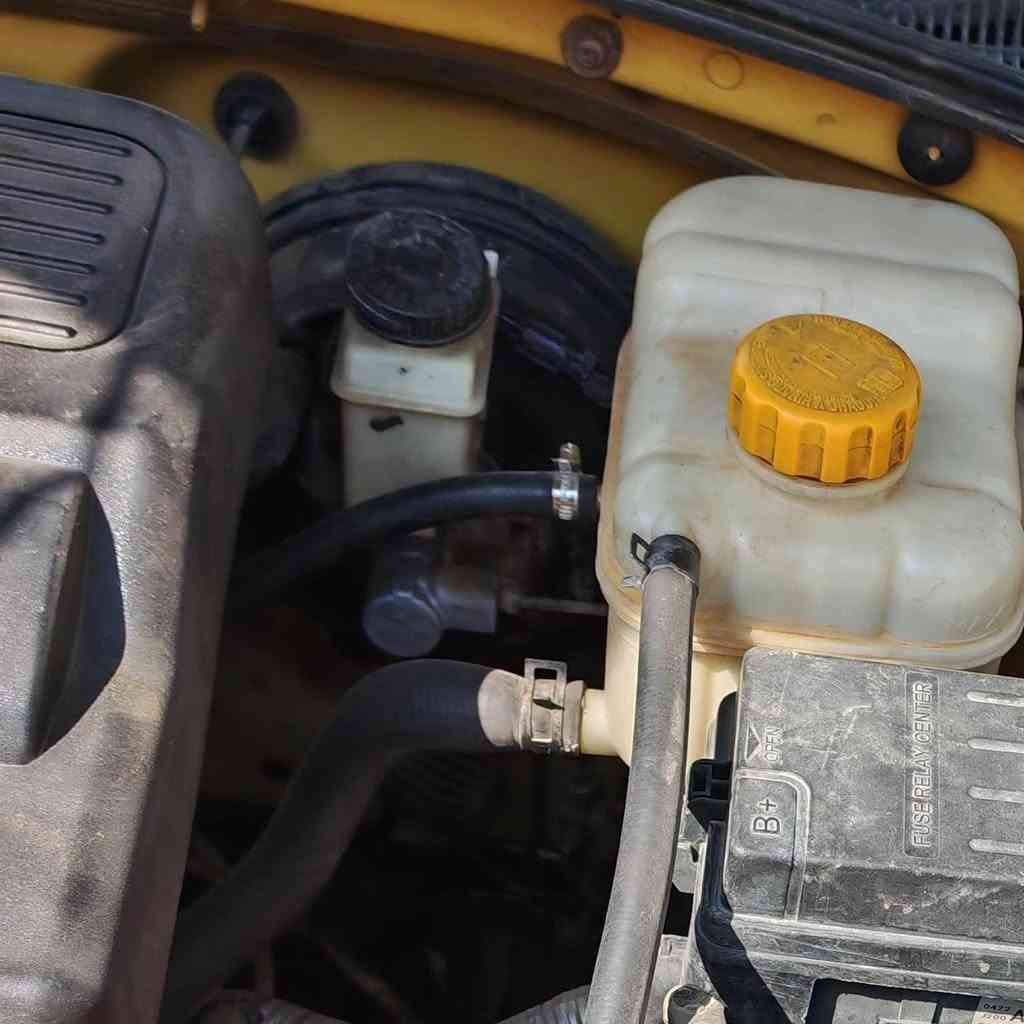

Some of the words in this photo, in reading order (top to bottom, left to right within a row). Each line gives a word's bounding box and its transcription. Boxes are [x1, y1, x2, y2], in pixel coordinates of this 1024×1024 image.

[912, 680, 932, 743] CENTER
[912, 746, 932, 797] RELAY
[752, 798, 781, 835] B+
[911, 800, 932, 847] FUSE
